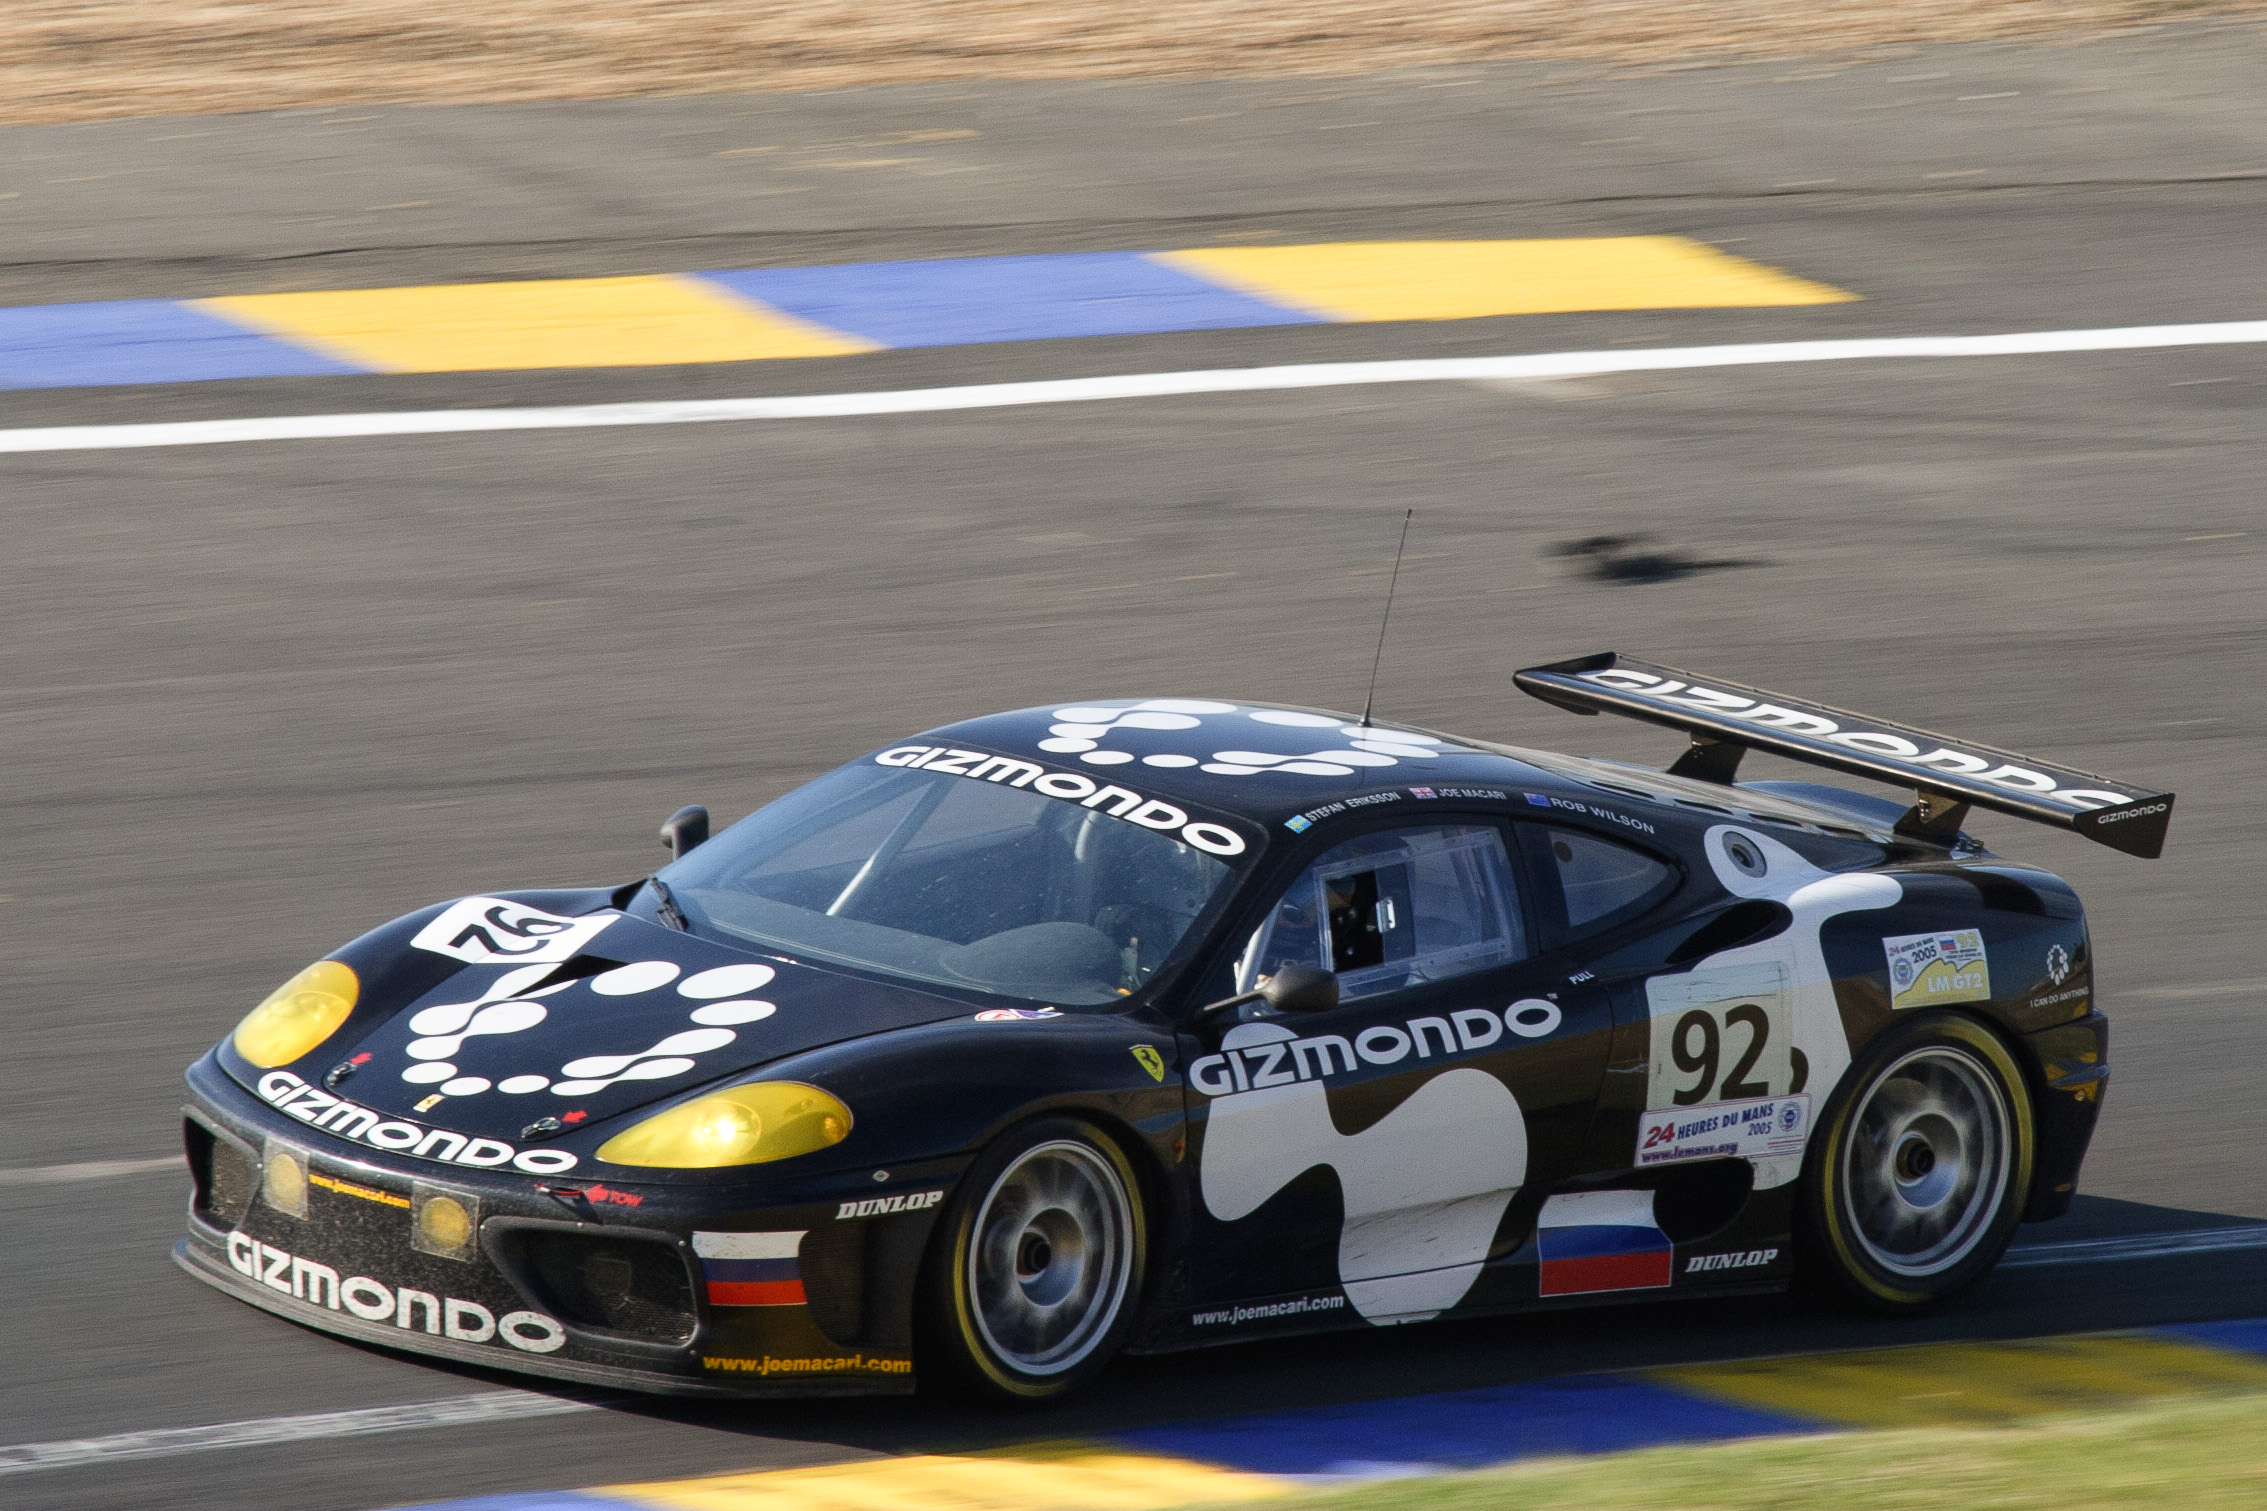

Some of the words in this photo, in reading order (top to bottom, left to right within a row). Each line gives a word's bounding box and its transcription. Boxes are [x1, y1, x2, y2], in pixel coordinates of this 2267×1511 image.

[1576, 669, 2134, 809] GIZMONDO
[875, 746, 1245, 855] GIZMONDO
[1305, 802, 1346, 822] STEFAN
[1345, 792, 1402, 808] ERIKSSON
[1439, 788, 1461, 798] JOE
[1461, 789, 1508, 800] MACARI
[1551, 797, 1587, 813] ROB
[1590, 805, 1655, 835] WILSON
[2097, 803, 2167, 824] GIZMONDO
[1911, 945, 1937, 963] 2005
[1569, 971, 1595, 985] PULL
[1926, 975, 1951, 993] LM
[1952, 972, 1983, 990] GT2
[1189, 998, 1562, 1096] GIZMONDO
[1672, 1004, 1770, 1106] 92
[258, 1071, 578, 1173] GIZMONDO
[1643, 1122, 1676, 1149] 24
[1677, 1116, 1719, 1140] HEURES
[1722, 1111, 1739, 1128] DU
[1741, 1102, 1775, 1124] MANS
[1747, 1121, 1774, 1137] 2005
[1641, 1142, 1739, 1163] www.lemans.org
[835, 1190, 944, 1220] DUNLOP
[1685, 1248, 1779, 1273] DUNLOP
[227, 1231, 567, 1353] GIZMONDO
[1192, 1295, 1345, 1326] www.joemacari.com
[703, 1354, 912, 1376] www.joemacari.com
